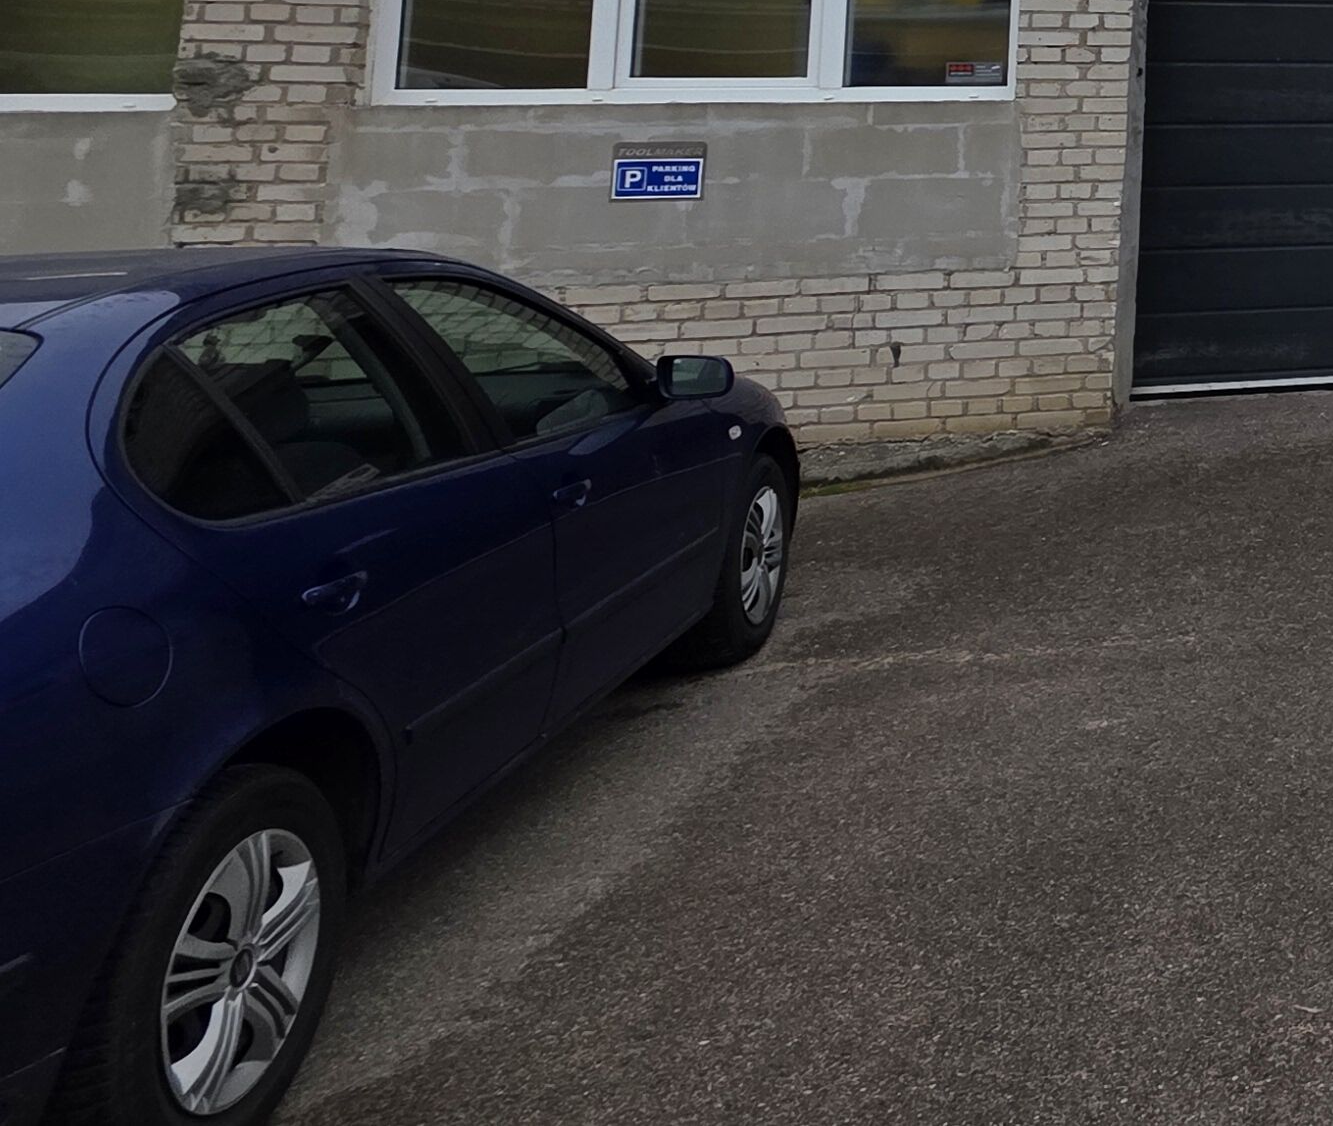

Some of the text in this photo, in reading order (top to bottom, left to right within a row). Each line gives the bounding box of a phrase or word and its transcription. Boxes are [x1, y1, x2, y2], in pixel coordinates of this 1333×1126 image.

[618, 147, 704, 157] TOOLMAKER
[624, 170, 642, 188] P
[646, 184, 697, 192] KLIENTÓW
